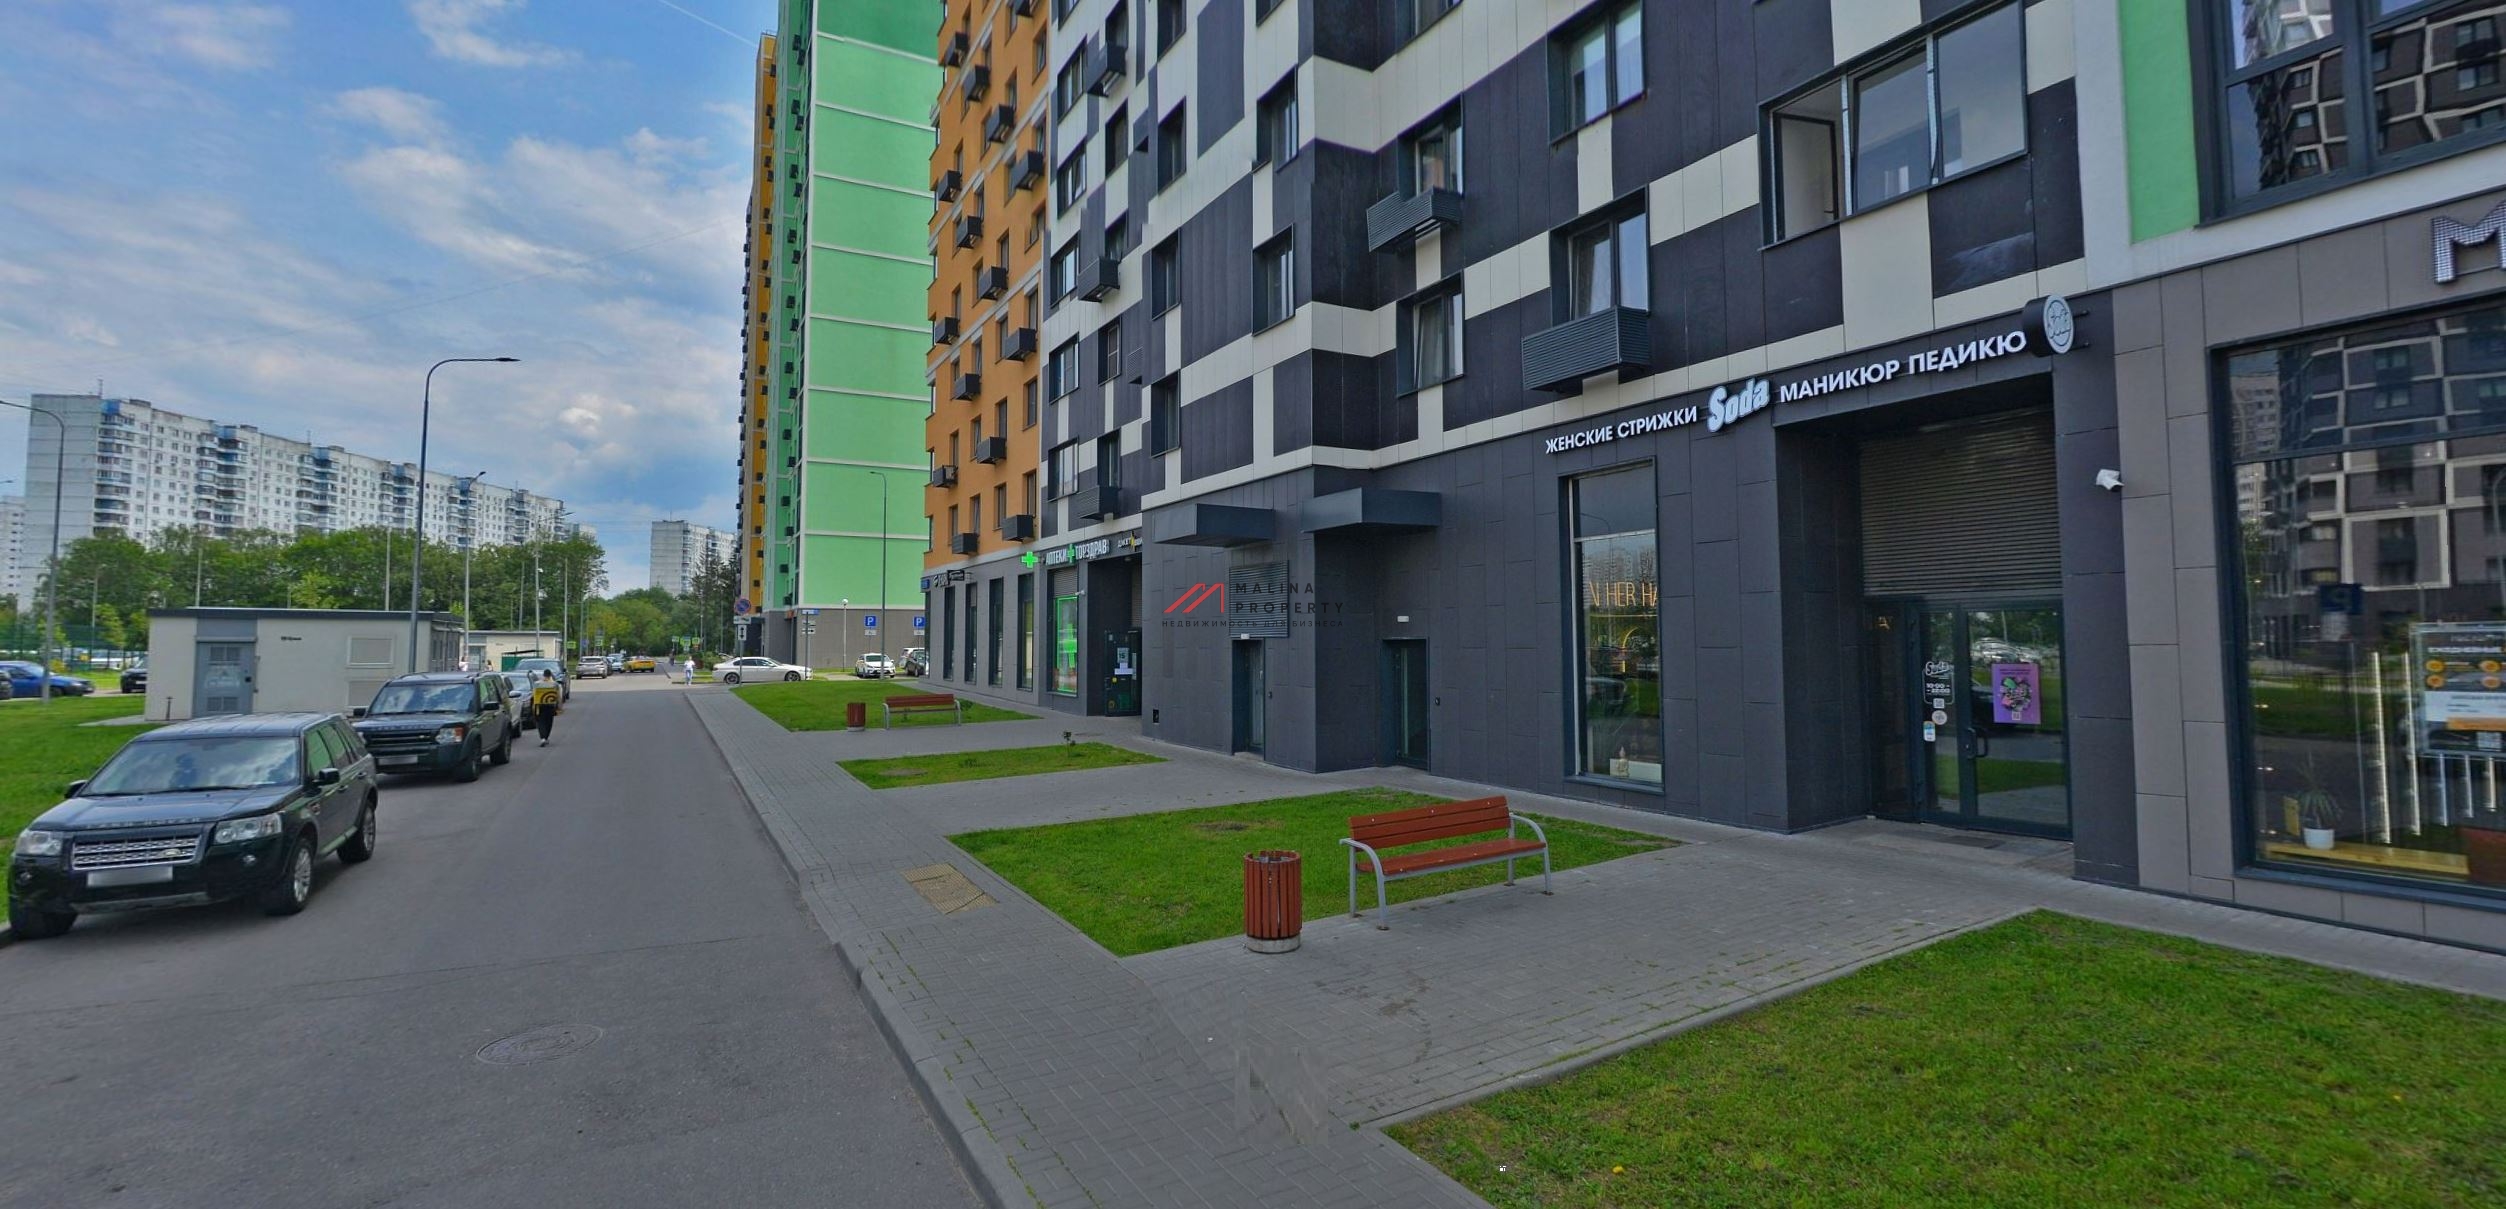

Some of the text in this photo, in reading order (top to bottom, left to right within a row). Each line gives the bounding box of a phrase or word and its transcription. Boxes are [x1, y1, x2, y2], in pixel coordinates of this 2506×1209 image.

[1779, 359, 1900, 403] МАНИКЮР
[1706, 378, 1770, 433] Soda
[1545, 405, 1697, 455] ЖЕНСКИЕ СТРИЖКИ
[1045, 539, 1109, 566] АПТЕКИ ГОРЗДРАВ
[1606, 581, 1636, 606] HER
